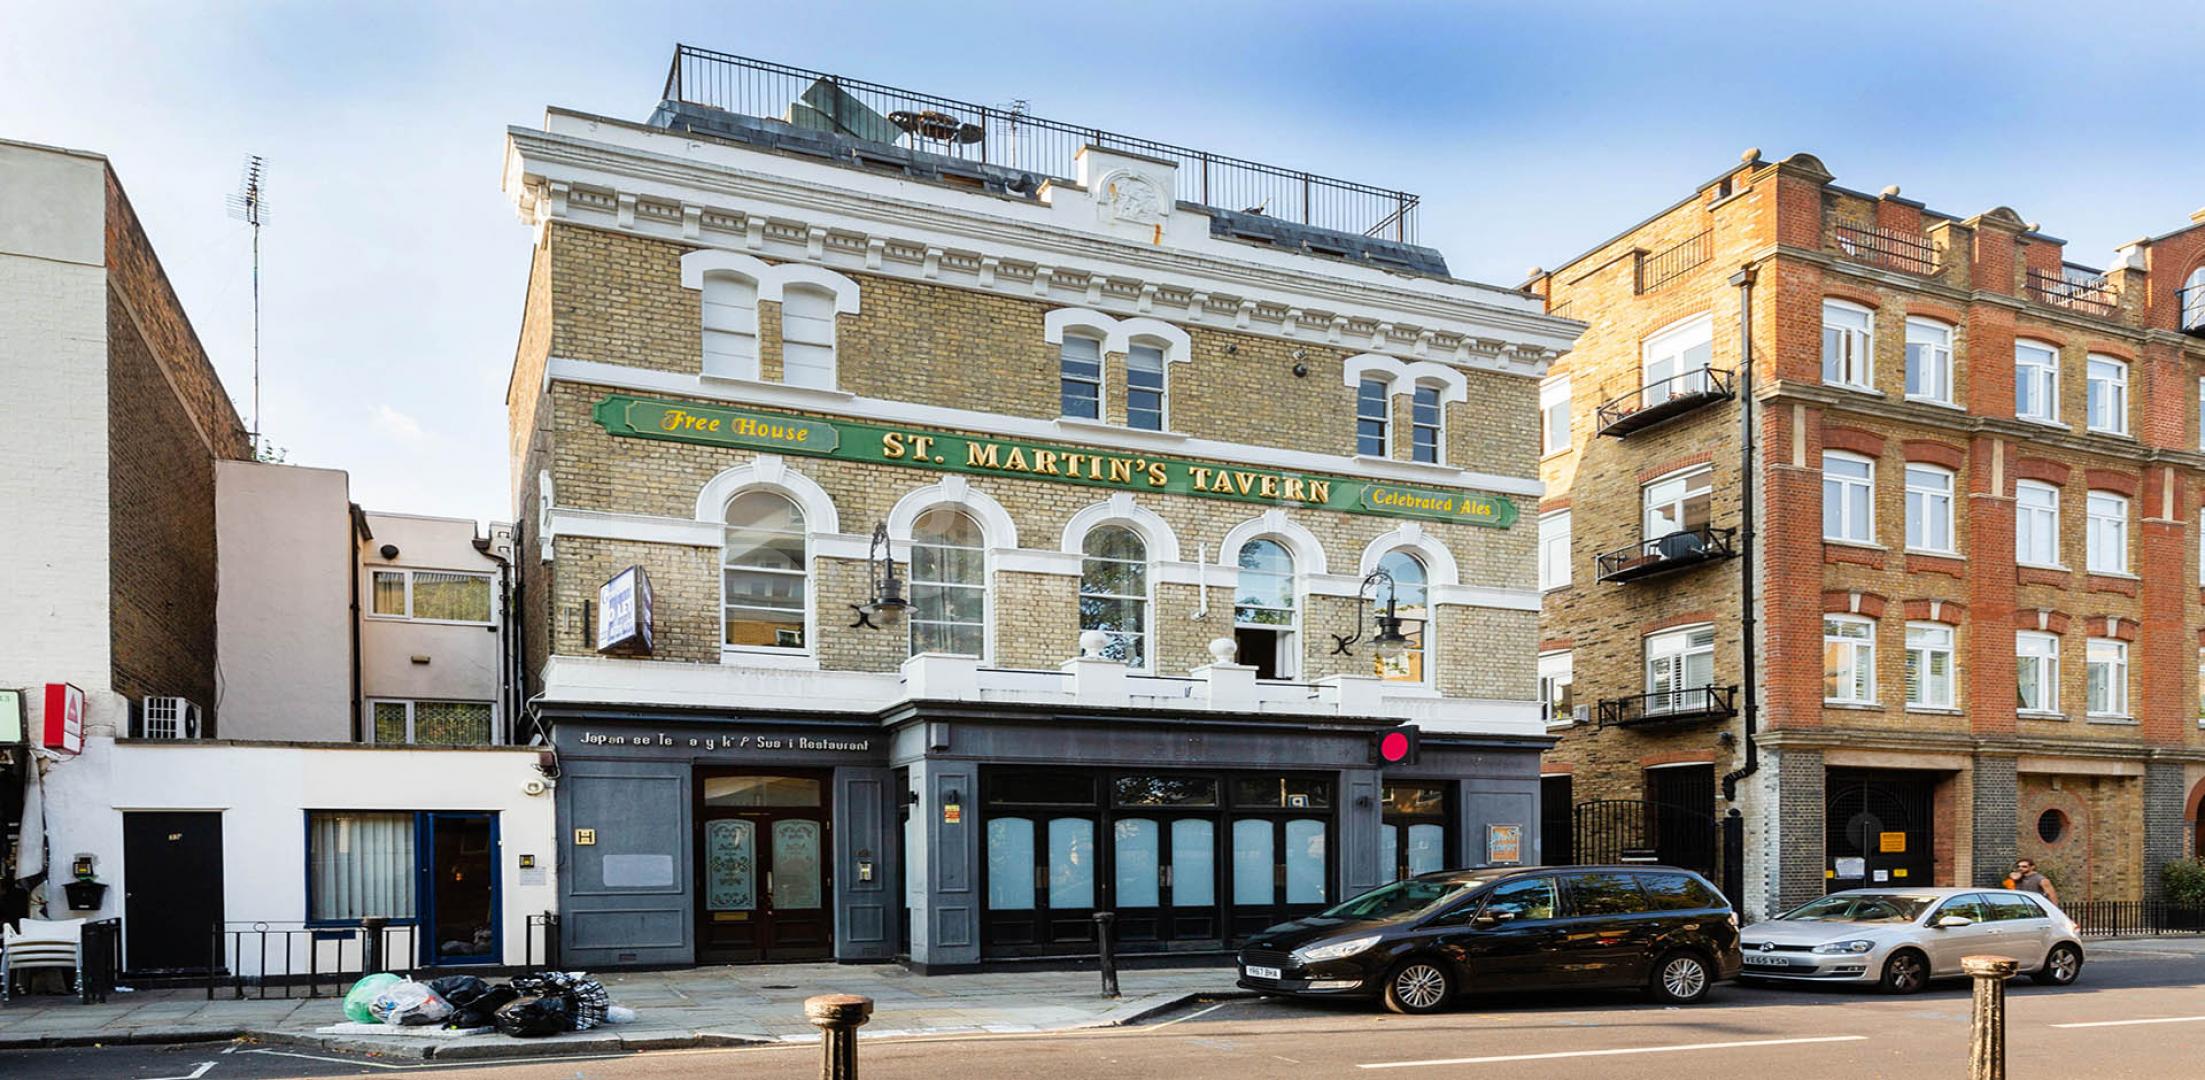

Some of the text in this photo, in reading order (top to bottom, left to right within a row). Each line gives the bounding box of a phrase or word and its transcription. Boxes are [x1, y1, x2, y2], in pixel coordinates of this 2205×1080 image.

[660, 409, 808, 442] Free House
[881, 431, 1331, 503] ST. MARTIN'S TAVERN
[1372, 488, 1492, 516] Celebrated Ales
[799, 736, 869, 751] Restaurant
